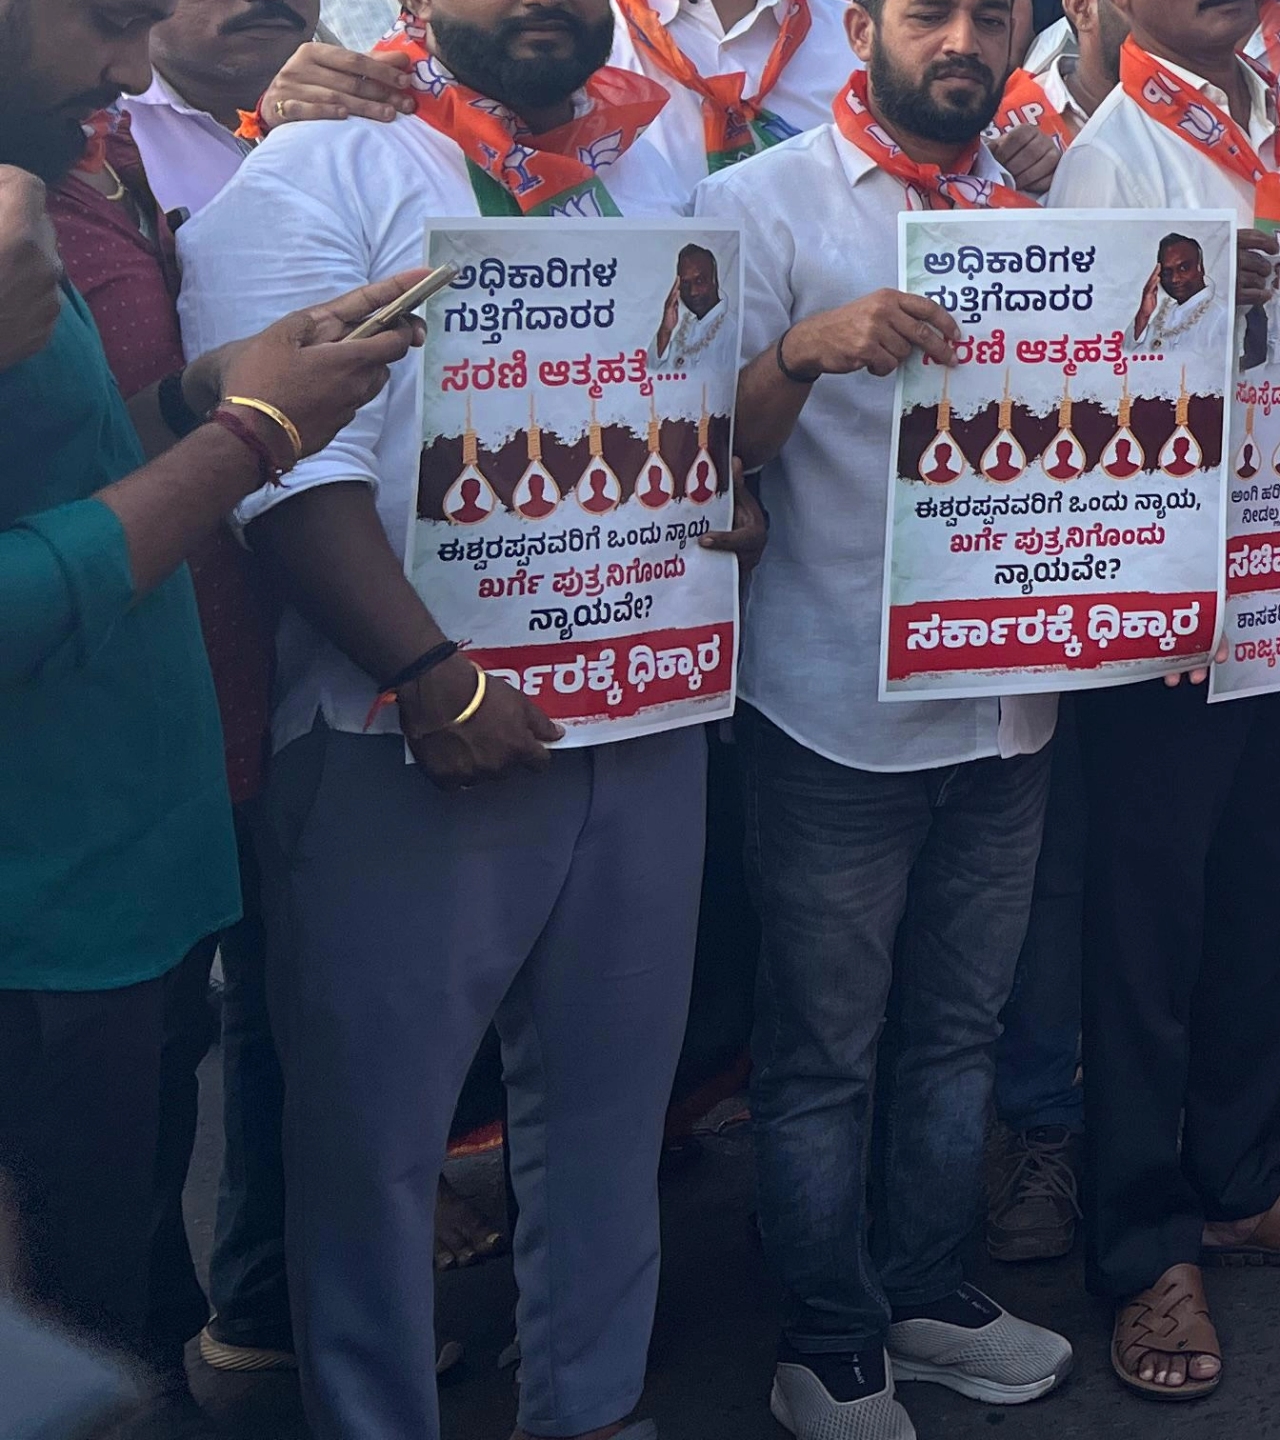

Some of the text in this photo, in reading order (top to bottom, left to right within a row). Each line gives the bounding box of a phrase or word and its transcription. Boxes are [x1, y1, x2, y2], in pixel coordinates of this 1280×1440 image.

[924, 245, 1095, 281] ಅಧಿಕಾರಿಗಳ
[444, 300, 614, 344] ಗುತ್ತಿಗೆದಾರರ
[441, 349, 528, 392] ಸರಣಿ
[915, 491, 1128, 527] ಈಶ್ವರಪ್ಪನವರಿಗೆ ಒಂದು
[437, 522, 660, 571] ಈಶ್ವರಪ್ಪನವರಿಗೆ ಒಂದು
[950, 530, 1006, 553] ಖರ್ಗೆ
[479, 571, 544, 600] ಖರ್ಗೆ
[906, 602, 1200, 657] ಸರ್ಕಾರಕ್ಕೆ ಧಿಕ್ಕಾರ
[628, 635, 720, 697] ಧಿಕ್ಕಾರ
